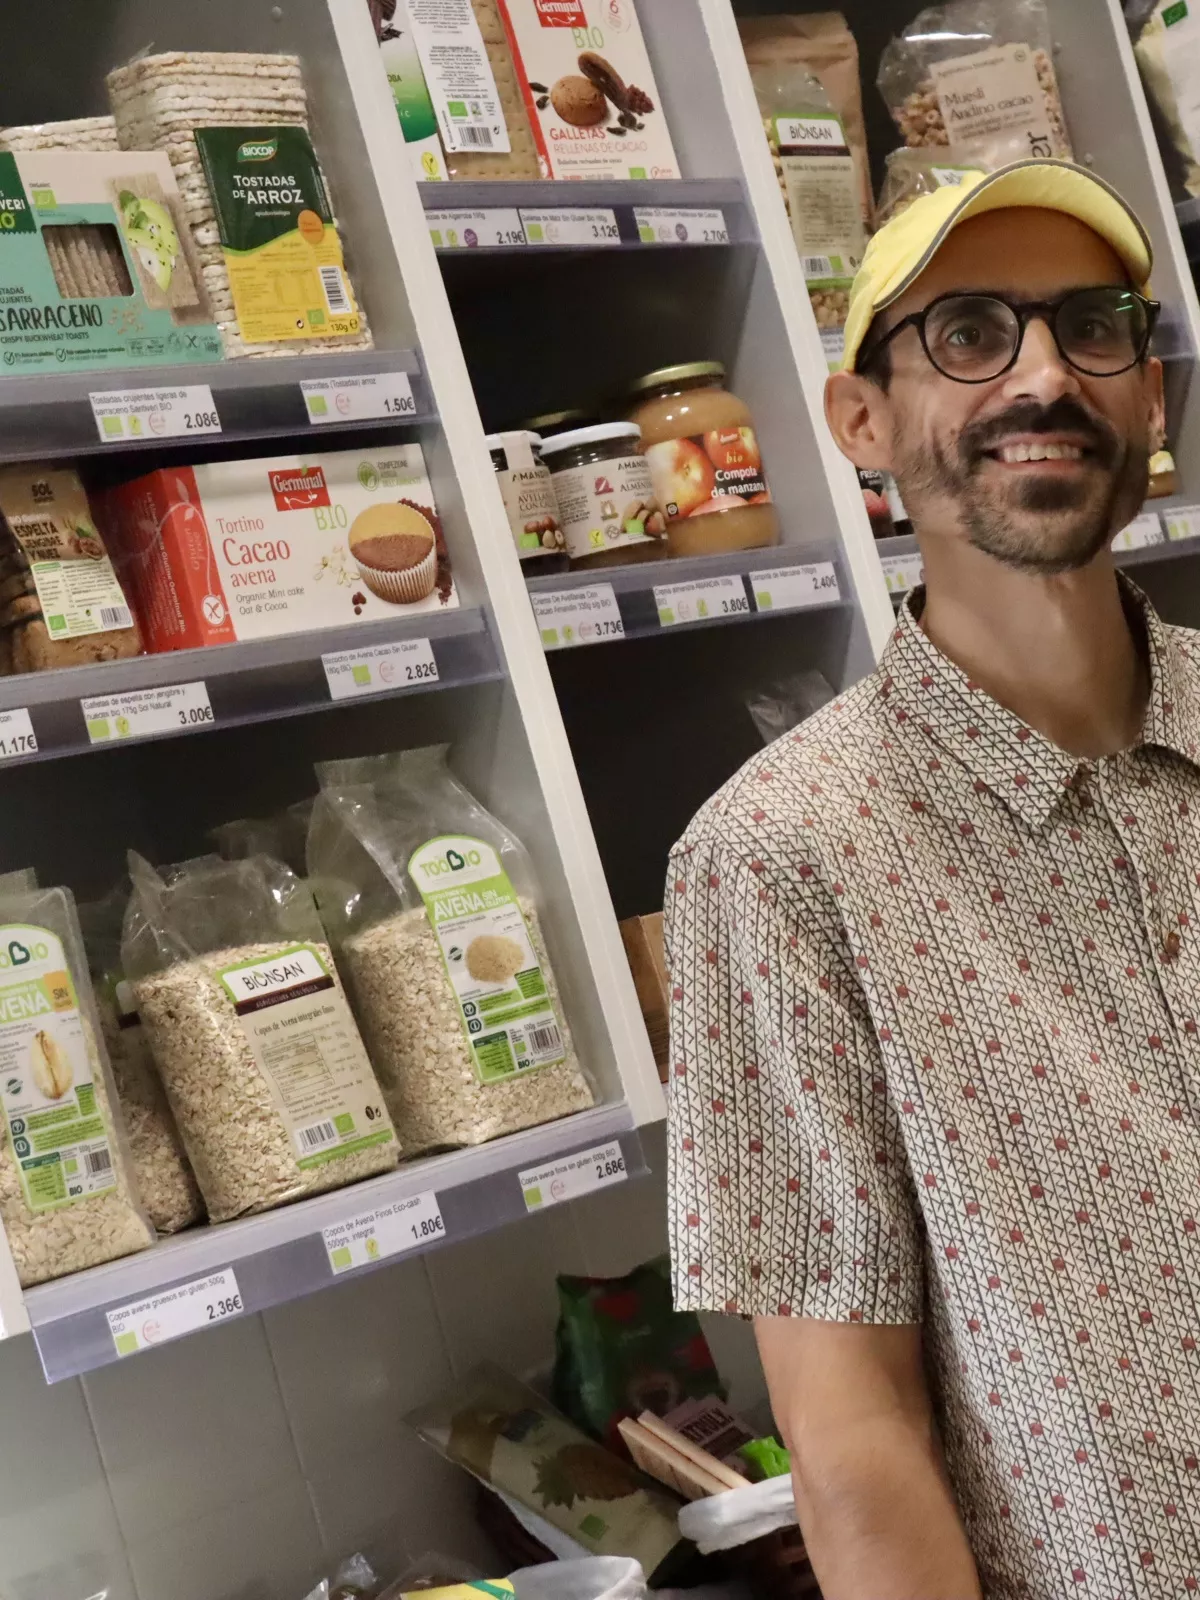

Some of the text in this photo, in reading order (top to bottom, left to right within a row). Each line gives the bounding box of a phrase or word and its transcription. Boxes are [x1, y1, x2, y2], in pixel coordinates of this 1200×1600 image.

[572, 26, 604, 48] BIO
[550, 128, 606, 140] GALLETAS
[242, 146, 276, 157] BIOCOP
[233, 174, 297, 188] TOSTADAS
[232, 189, 305, 205] DE ARROZ
[495, 230, 524, 244] 2.19€
[592, 224, 619, 238] 3.12€
[330, 322, 349, 333] 130g
[384, 396, 415, 413] 1.50€
[183, 411, 220, 429] 2.08€
[725, 449, 744, 465] bio
[273, 472, 324, 493] Germinal
[715, 465, 758, 482] Compota
[710, 481, 765, 499] de manzana
[215, 515, 265, 535] Tortino
[314, 504, 347, 531] BIO
[14, 521, 59, 538] ESPELTA
[222, 537, 291, 568] Cacao
[230, 567, 277, 589] avena
[812, 576, 837, 591] 2.40€
[235, 585, 305, 605] Organic Mini cake
[239, 605, 255, 616] Oat
[263, 600, 289, 613] Cocoa
[721, 597, 748, 614] 3.80€
[595, 619, 623, 636] 3.73€
[405, 661, 437, 681] 2.82€
[178, 706, 214, 725] 3.00€
[0, 735, 38, 756] 1.17€
[434, 891, 486, 921] AVENA
[241, 961, 306, 991] BIONSAN
[253, 1023, 273, 1037] Copos
[272, 1021, 280, 1031] de
[280, 1014, 298, 1028] Avena
[517, 1058, 531, 1070] BIO
[595, 1157, 625, 1180] 2.68€
[69, 1184, 83, 1197] BIO
[323, 1196, 422, 1239] Copos de Avena Finos Eco-cash
[351, 1225, 376, 1241] integral
[410, 1215, 444, 1240] 1.80€
[108, 1275, 226, 1323] Copos avena gruesos sin gluten 500g
[206, 1294, 242, 1320] 2.36€
[111, 1322, 126, 1334] BIO
